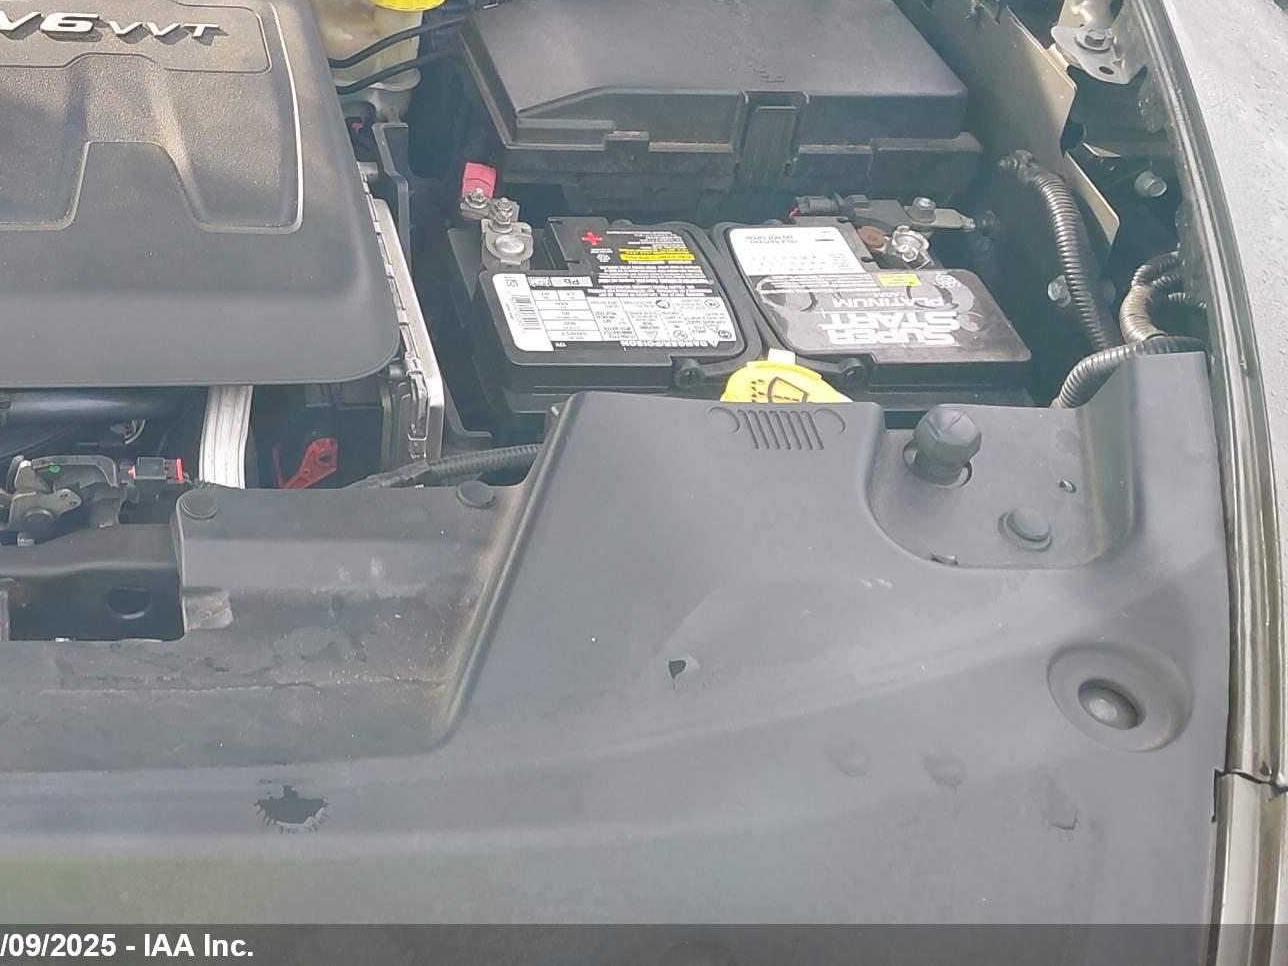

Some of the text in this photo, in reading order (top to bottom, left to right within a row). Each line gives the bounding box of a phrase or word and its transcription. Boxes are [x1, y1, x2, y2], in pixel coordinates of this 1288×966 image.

[108, 20, 220, 37] VVT
[832, 297, 945, 309] PLATINUM
[817, 311, 961, 330] START
[827, 328, 957, 345] SUPER
